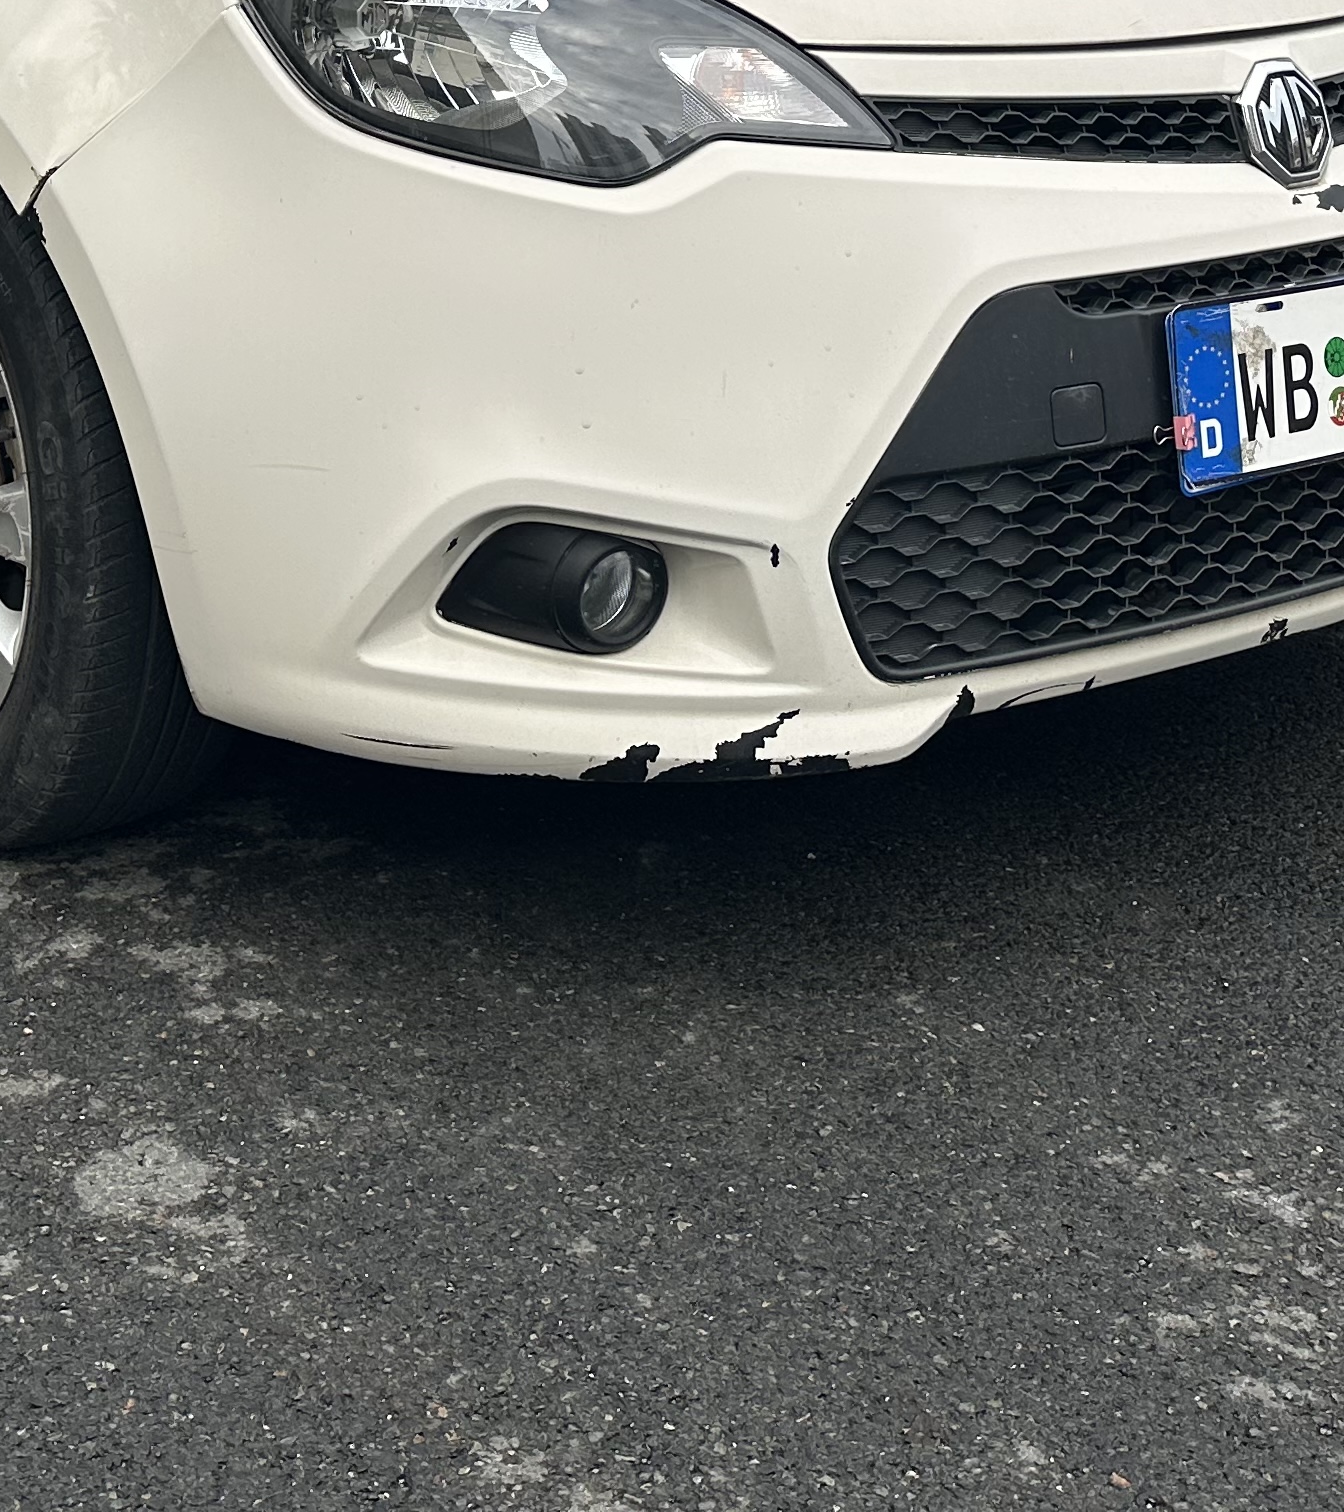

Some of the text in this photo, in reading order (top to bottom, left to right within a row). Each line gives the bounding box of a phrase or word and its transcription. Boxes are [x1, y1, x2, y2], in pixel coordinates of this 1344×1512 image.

[1257, 72, 1326, 176] MG
[1199, 418, 1223, 459] D
[1238, 342, 1319, 442] WB
